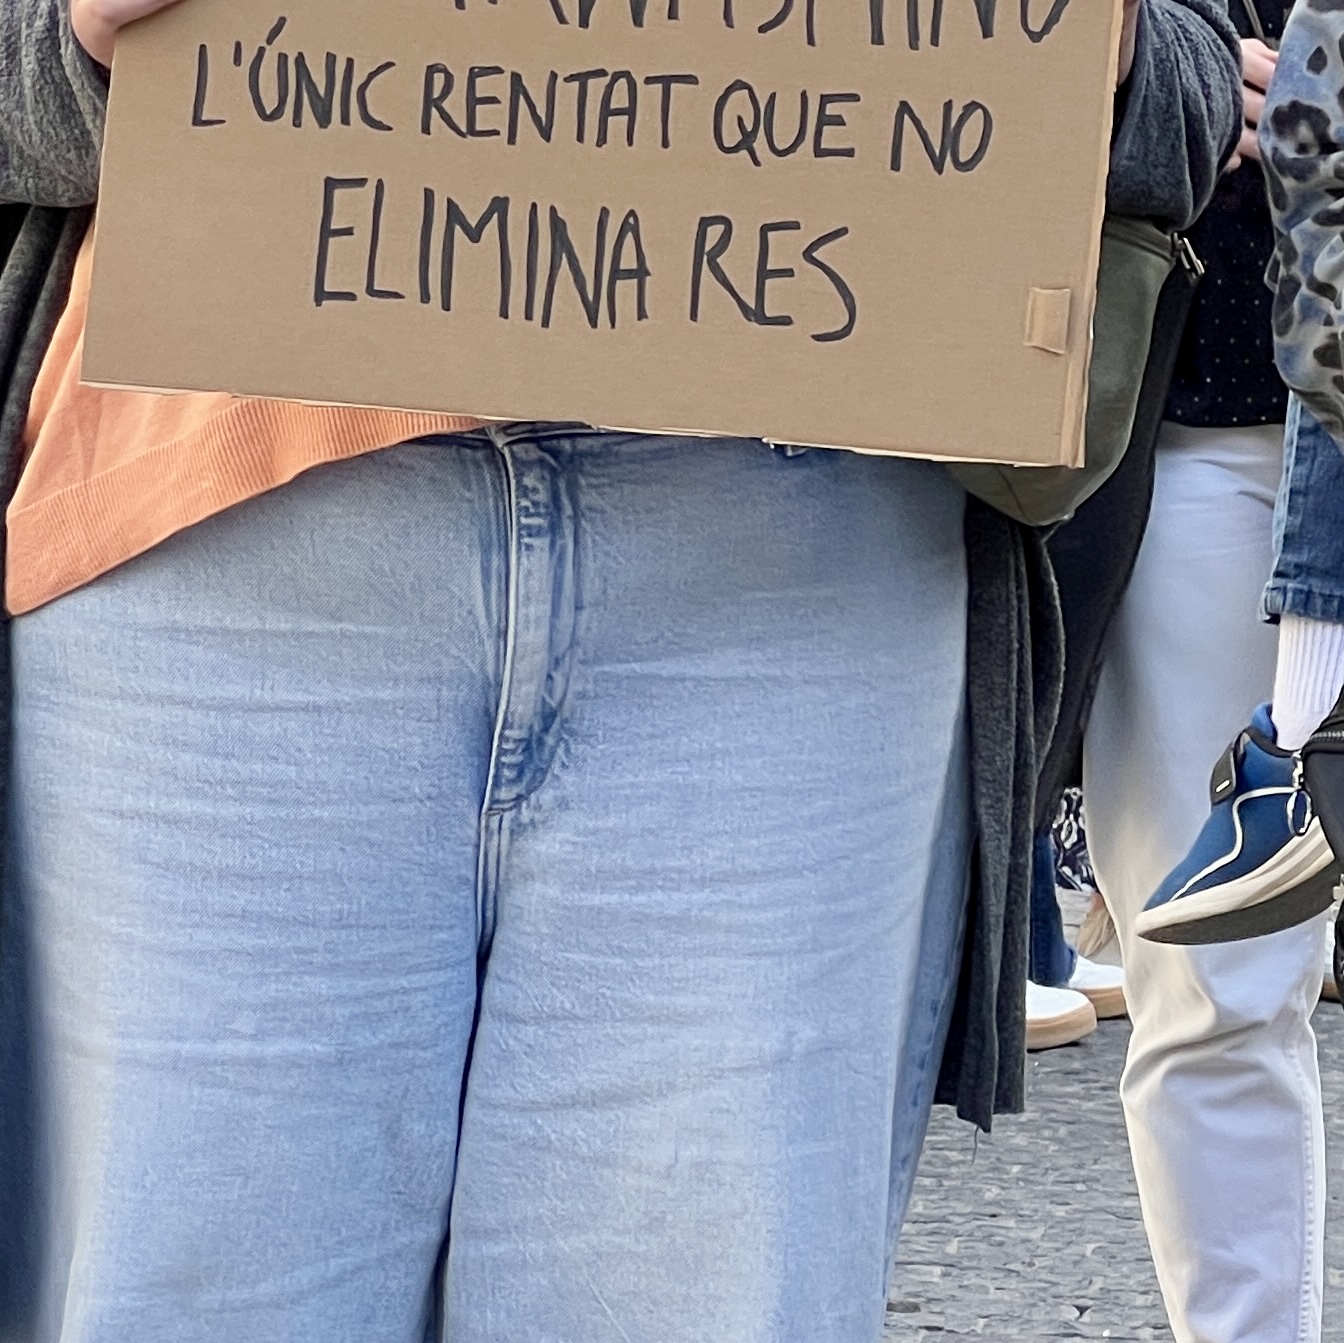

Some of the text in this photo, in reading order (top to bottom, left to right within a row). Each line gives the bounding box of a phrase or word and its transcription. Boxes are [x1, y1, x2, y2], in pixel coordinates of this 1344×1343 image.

[192, 16, 993, 176] L'ÚNIC RENTAT QUE NO
[313, 175, 857, 343] ELIMINA RES
